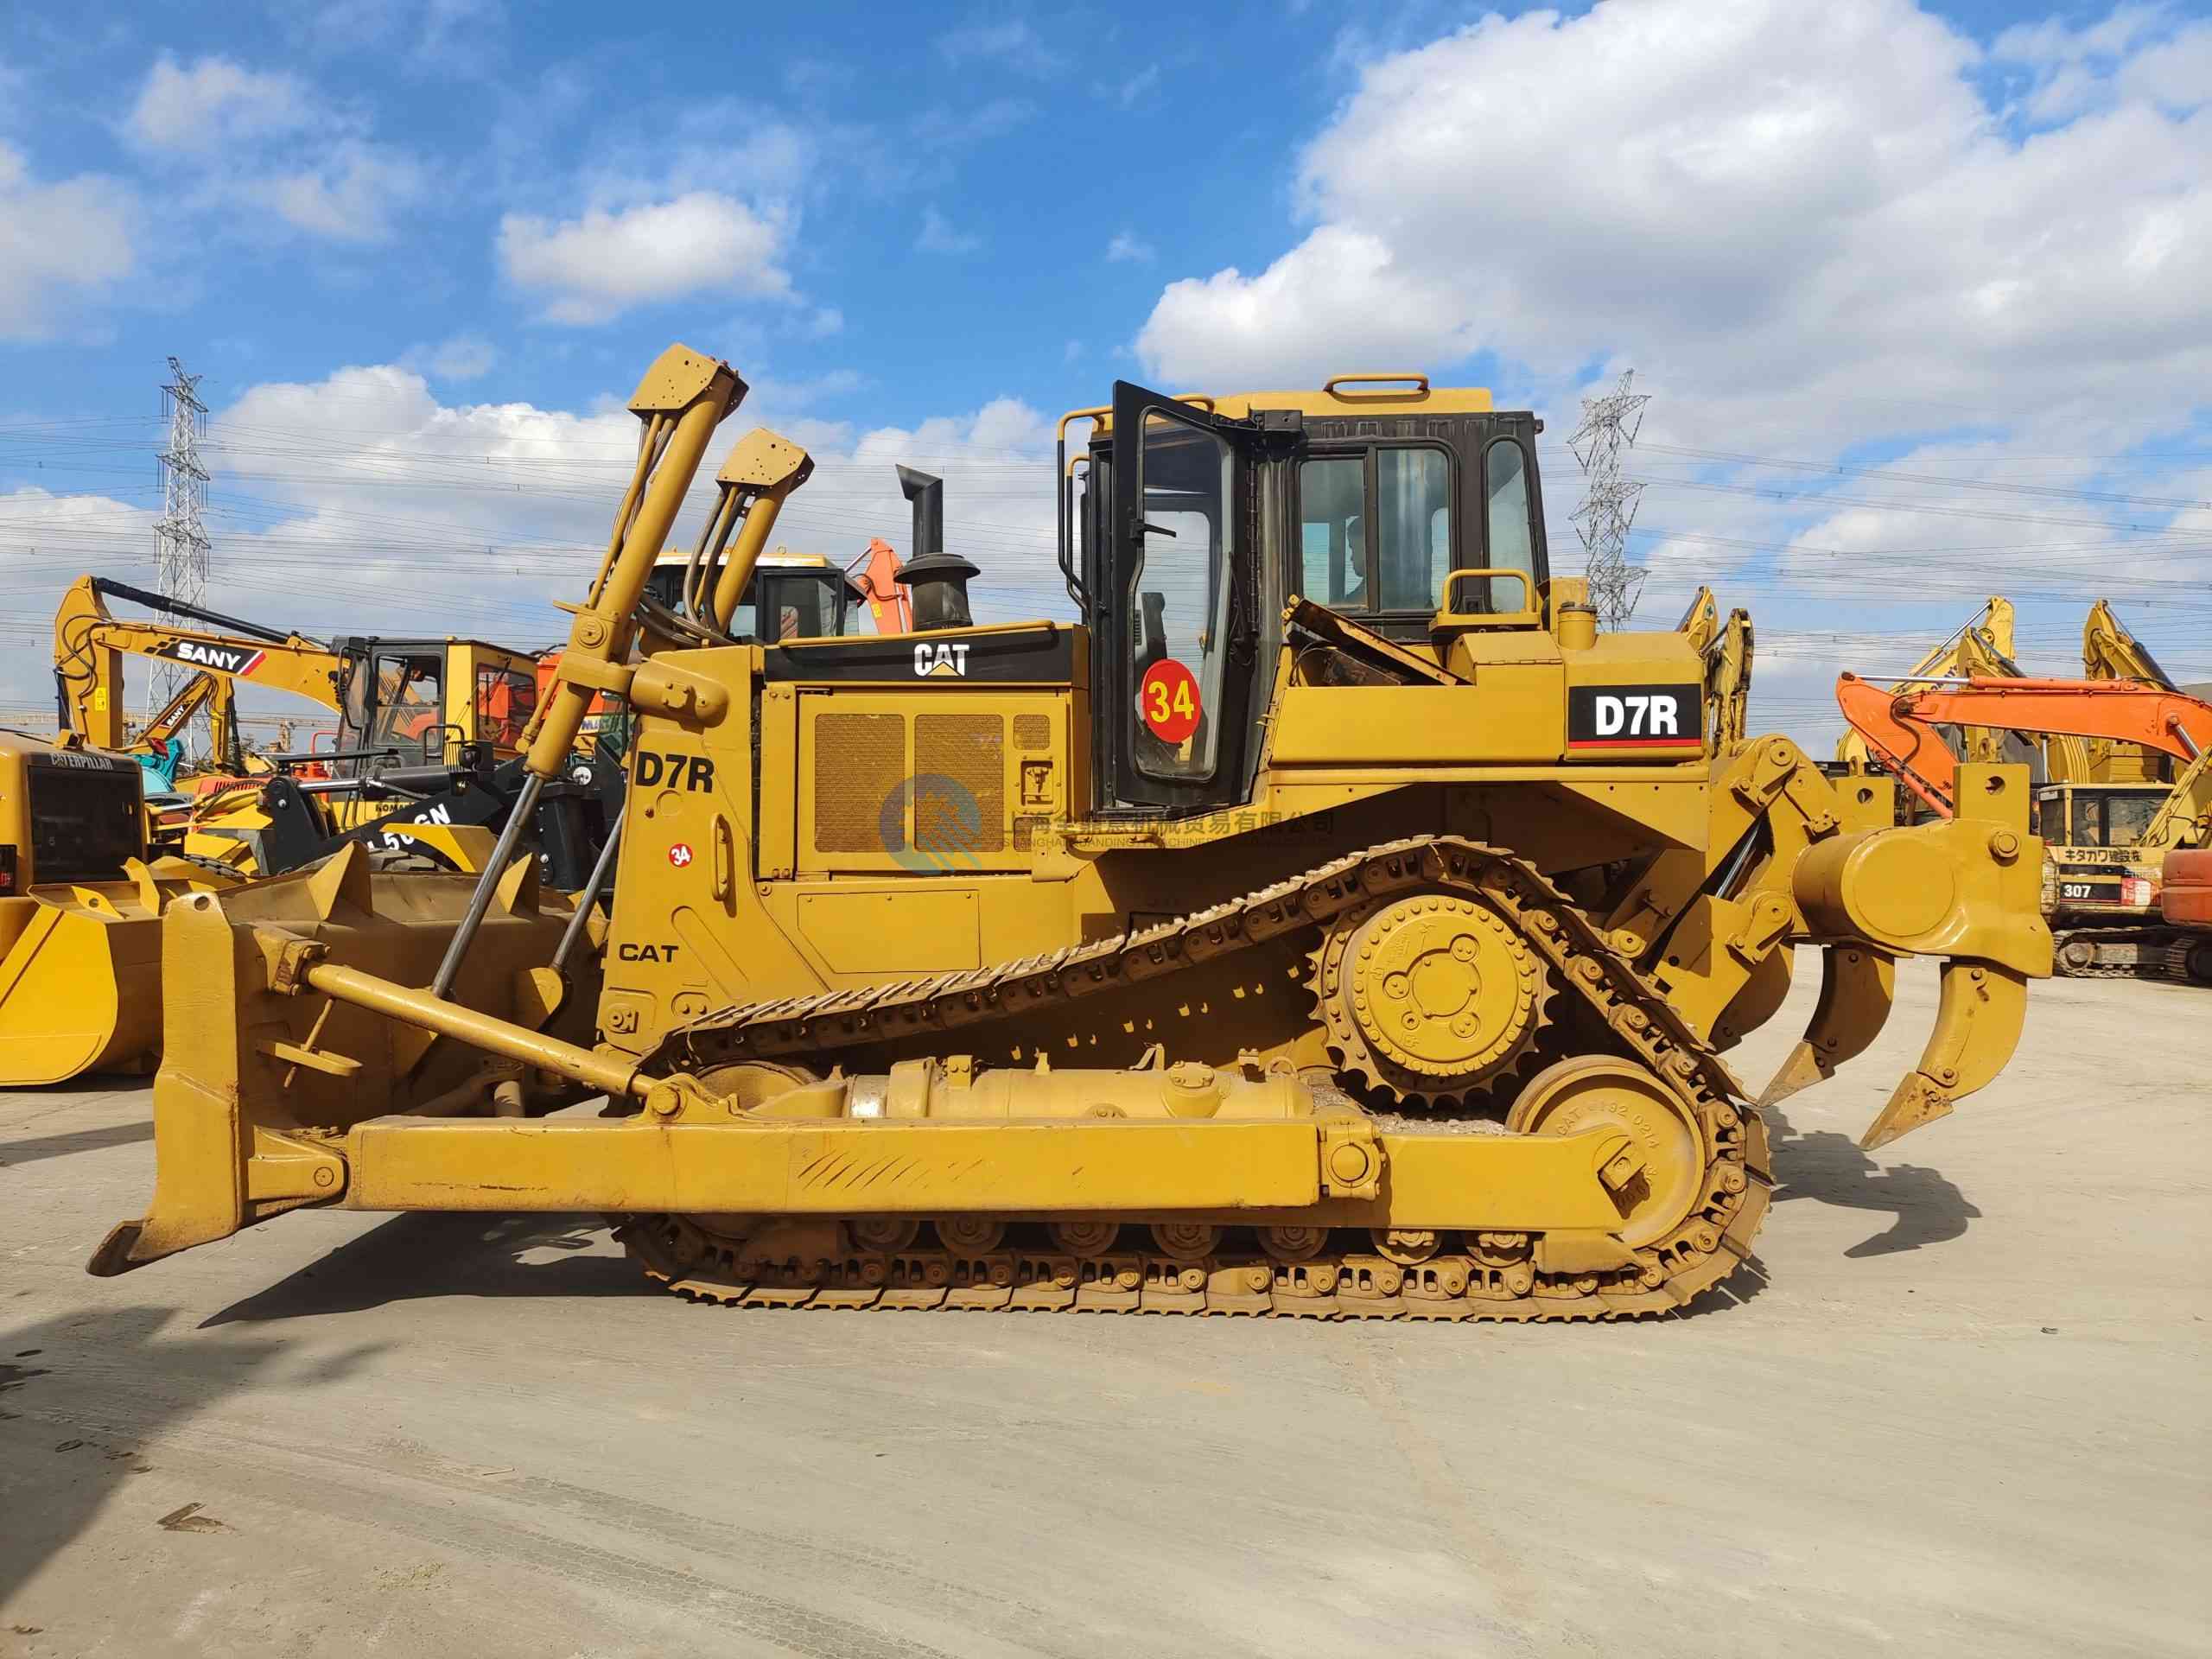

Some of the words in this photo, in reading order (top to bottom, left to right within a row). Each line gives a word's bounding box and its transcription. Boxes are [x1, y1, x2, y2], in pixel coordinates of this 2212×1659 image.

[178, 642, 241, 671] SANY
[914, 643, 969, 677] CAT
[1147, 679, 1195, 723] 34
[166, 705, 185, 727] SANY
[1595, 696, 1678, 735] D7R
[49, 753, 113, 770] CATERPILLAR
[635, 751, 714, 793] D7R
[671, 845, 692, 868] 34
[2064, 884, 2092, 899] 307
[618, 943, 679, 963] CAT
